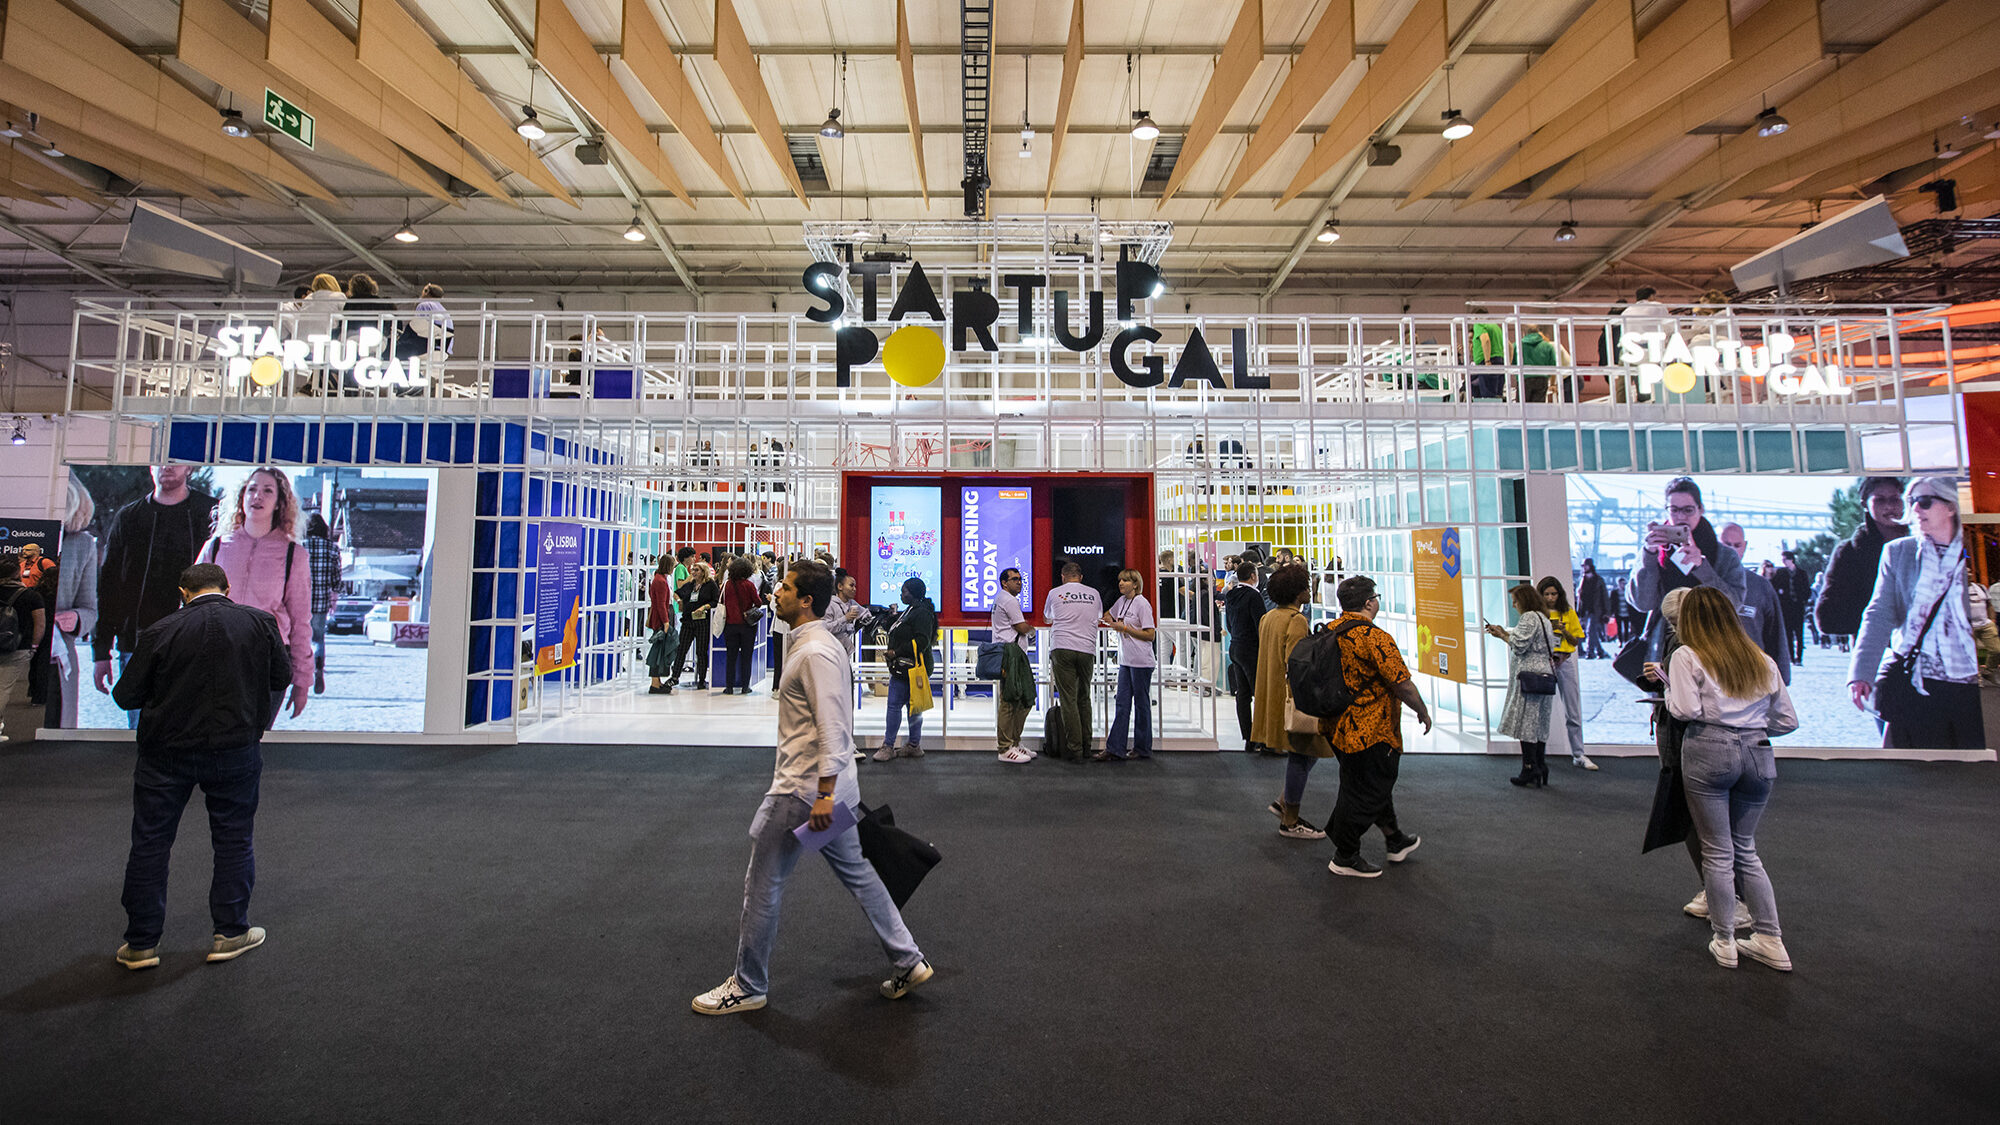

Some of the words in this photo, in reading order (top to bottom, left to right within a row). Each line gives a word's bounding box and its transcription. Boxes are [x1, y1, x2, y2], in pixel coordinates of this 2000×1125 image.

[802, 260, 1161, 352] STARTUP
[216, 325, 384, 371] STARTUP
[1619, 331, 1795, 376] STARTUP
[3, 545, 44, 554] Plat
[555, 536, 578, 548] LISBOA
[964, 490, 979, 607] HAPPENING
[983, 540, 998, 608] TODAY
